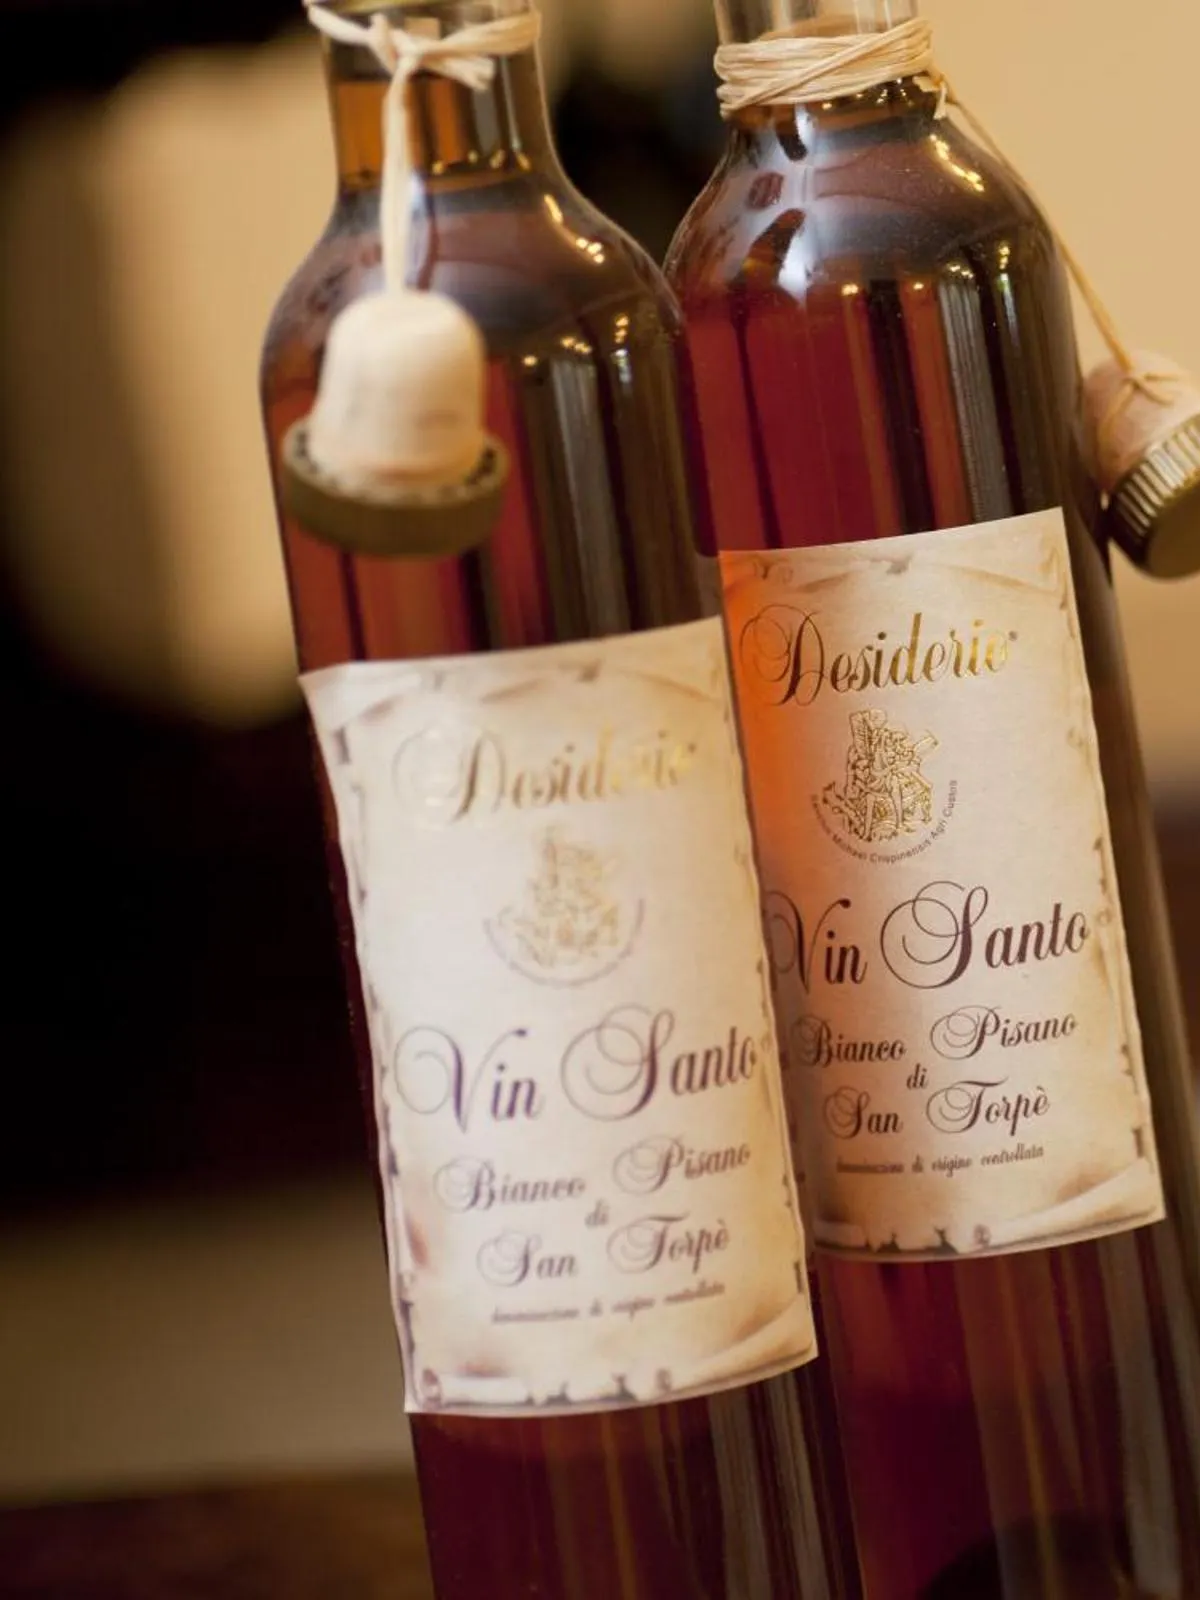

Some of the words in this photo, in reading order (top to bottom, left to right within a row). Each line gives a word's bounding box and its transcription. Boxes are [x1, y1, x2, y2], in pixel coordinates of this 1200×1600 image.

[740, 604, 1008, 706] Desiderio
[769, 890, 869, 994] Vin
[880, 881, 1090, 989] Santo
[394, 1026, 541, 1133] Vin
[561, 1004, 758, 1121] Santo
[791, 1015, 906, 1068] Bianco
[930, 1005, 1079, 1060] Pisano
[824, 1086, 901, 1140] San
[926, 1076, 1050, 1136] Torpè
[906, 1064, 928, 1093] di
[433, 1155, 586, 1211] Bianco
[612, 1134, 751, 1195] Pisano
[477, 1230, 578, 1287] San
[606, 1213, 731, 1275] Torpè
[585, 1200, 611, 1229] di
